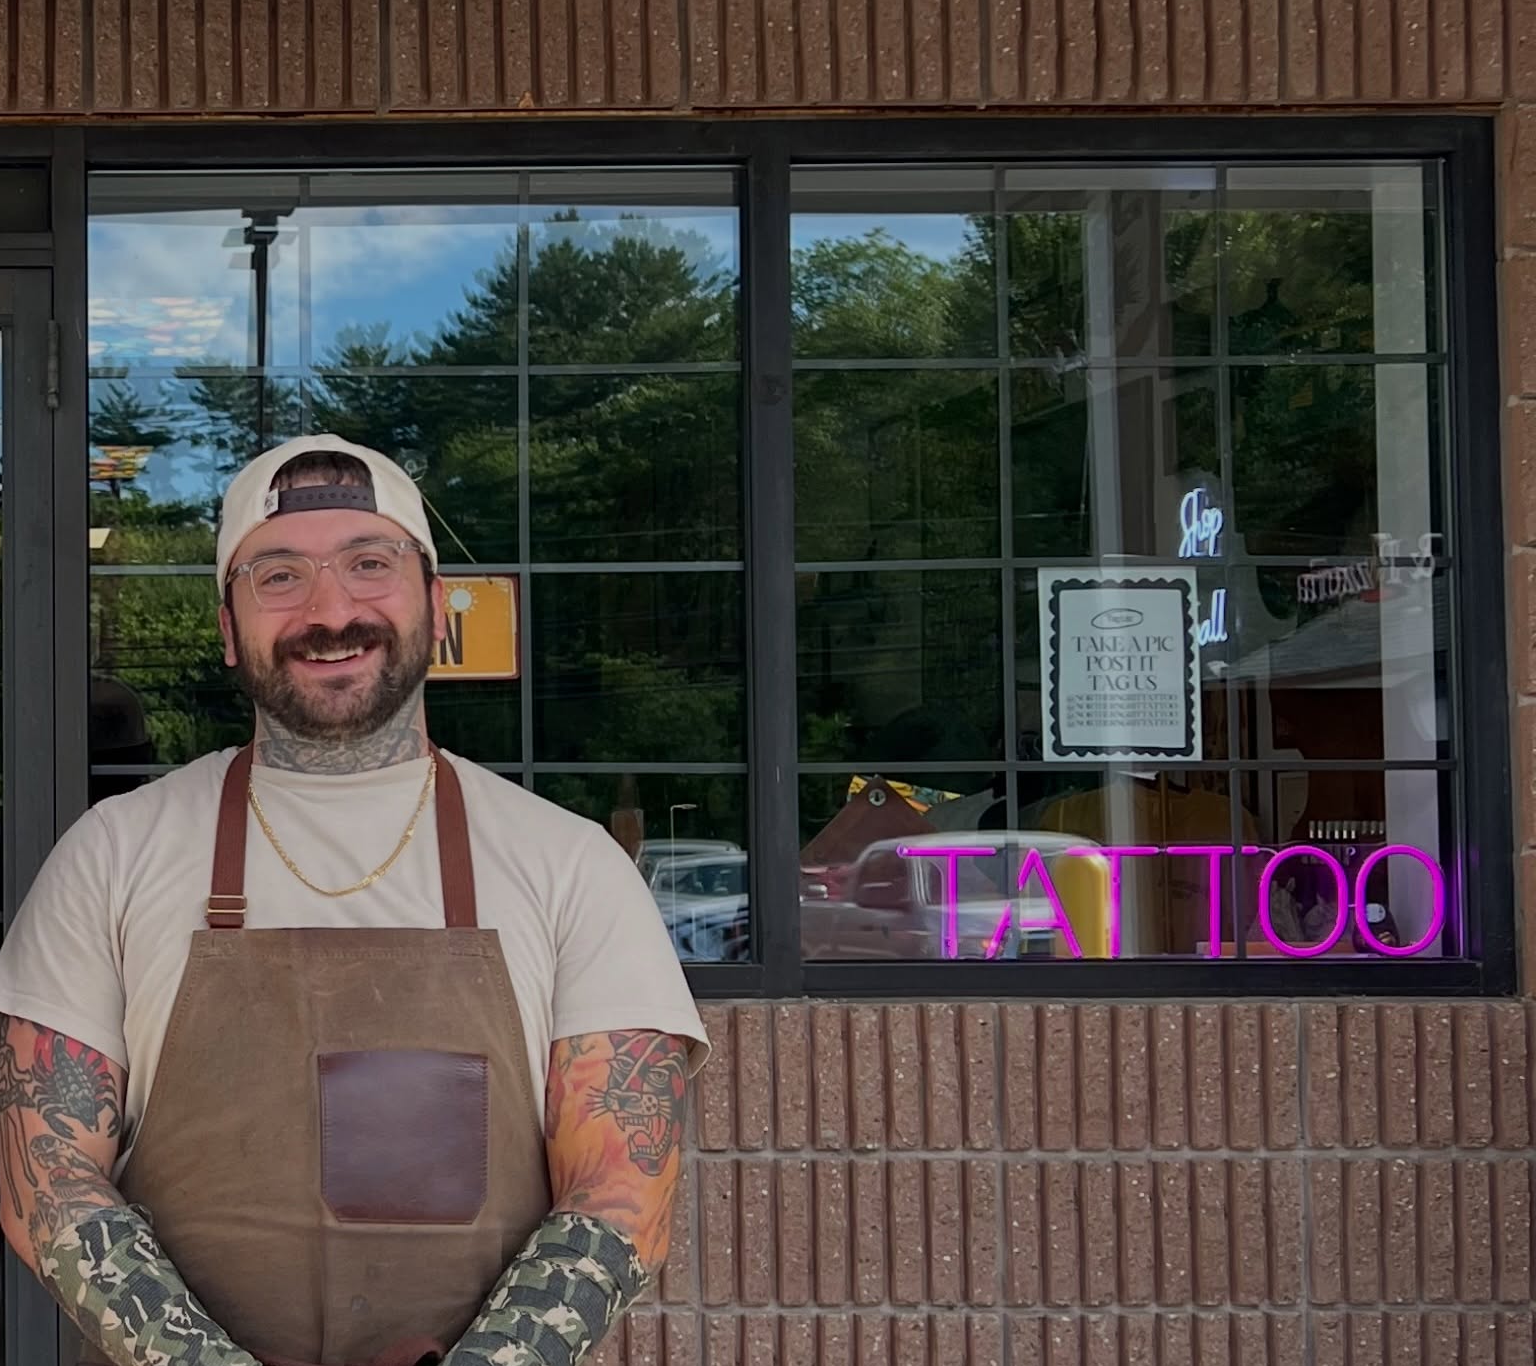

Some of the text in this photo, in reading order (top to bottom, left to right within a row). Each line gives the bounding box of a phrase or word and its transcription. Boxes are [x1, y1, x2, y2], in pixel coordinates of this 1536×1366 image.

[1072, 636, 1176, 653] TAKE A PIC
[1086, 655, 1159, 672] POST IT
[1087, 675, 1158, 691] TAG US
[897, 843, 1446, 959] TATTOO
